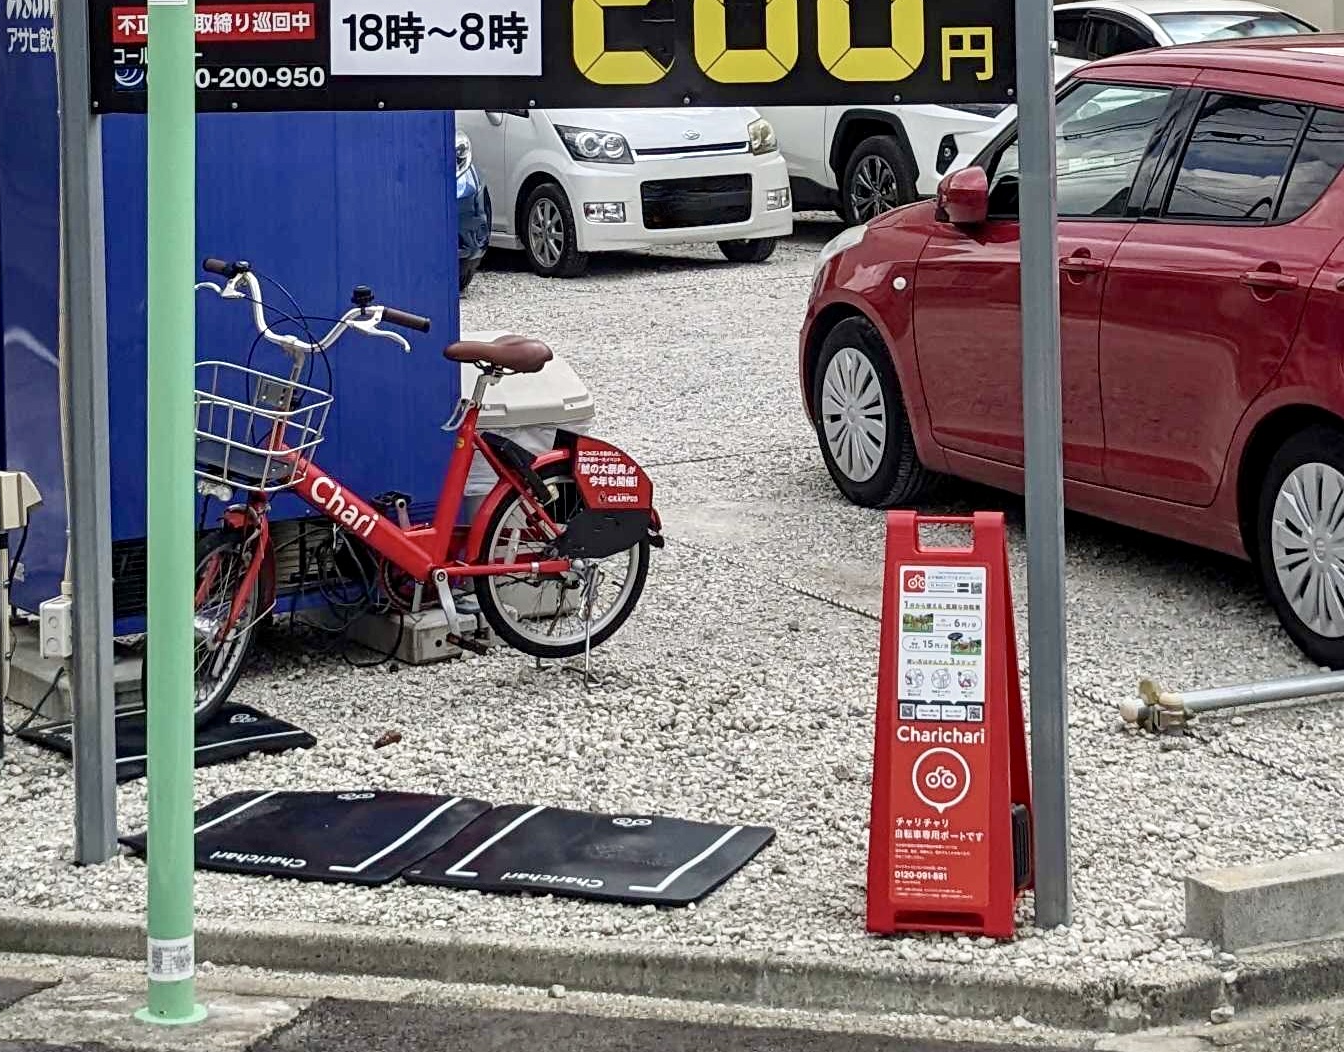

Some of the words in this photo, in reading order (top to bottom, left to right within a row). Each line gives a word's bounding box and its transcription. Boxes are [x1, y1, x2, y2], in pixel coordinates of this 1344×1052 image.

[896, 725, 985, 744] Charichari
[895, 816, 949, 828] チャリチャリ
[894, 828, 984, 843] 自転車専用ポートです
